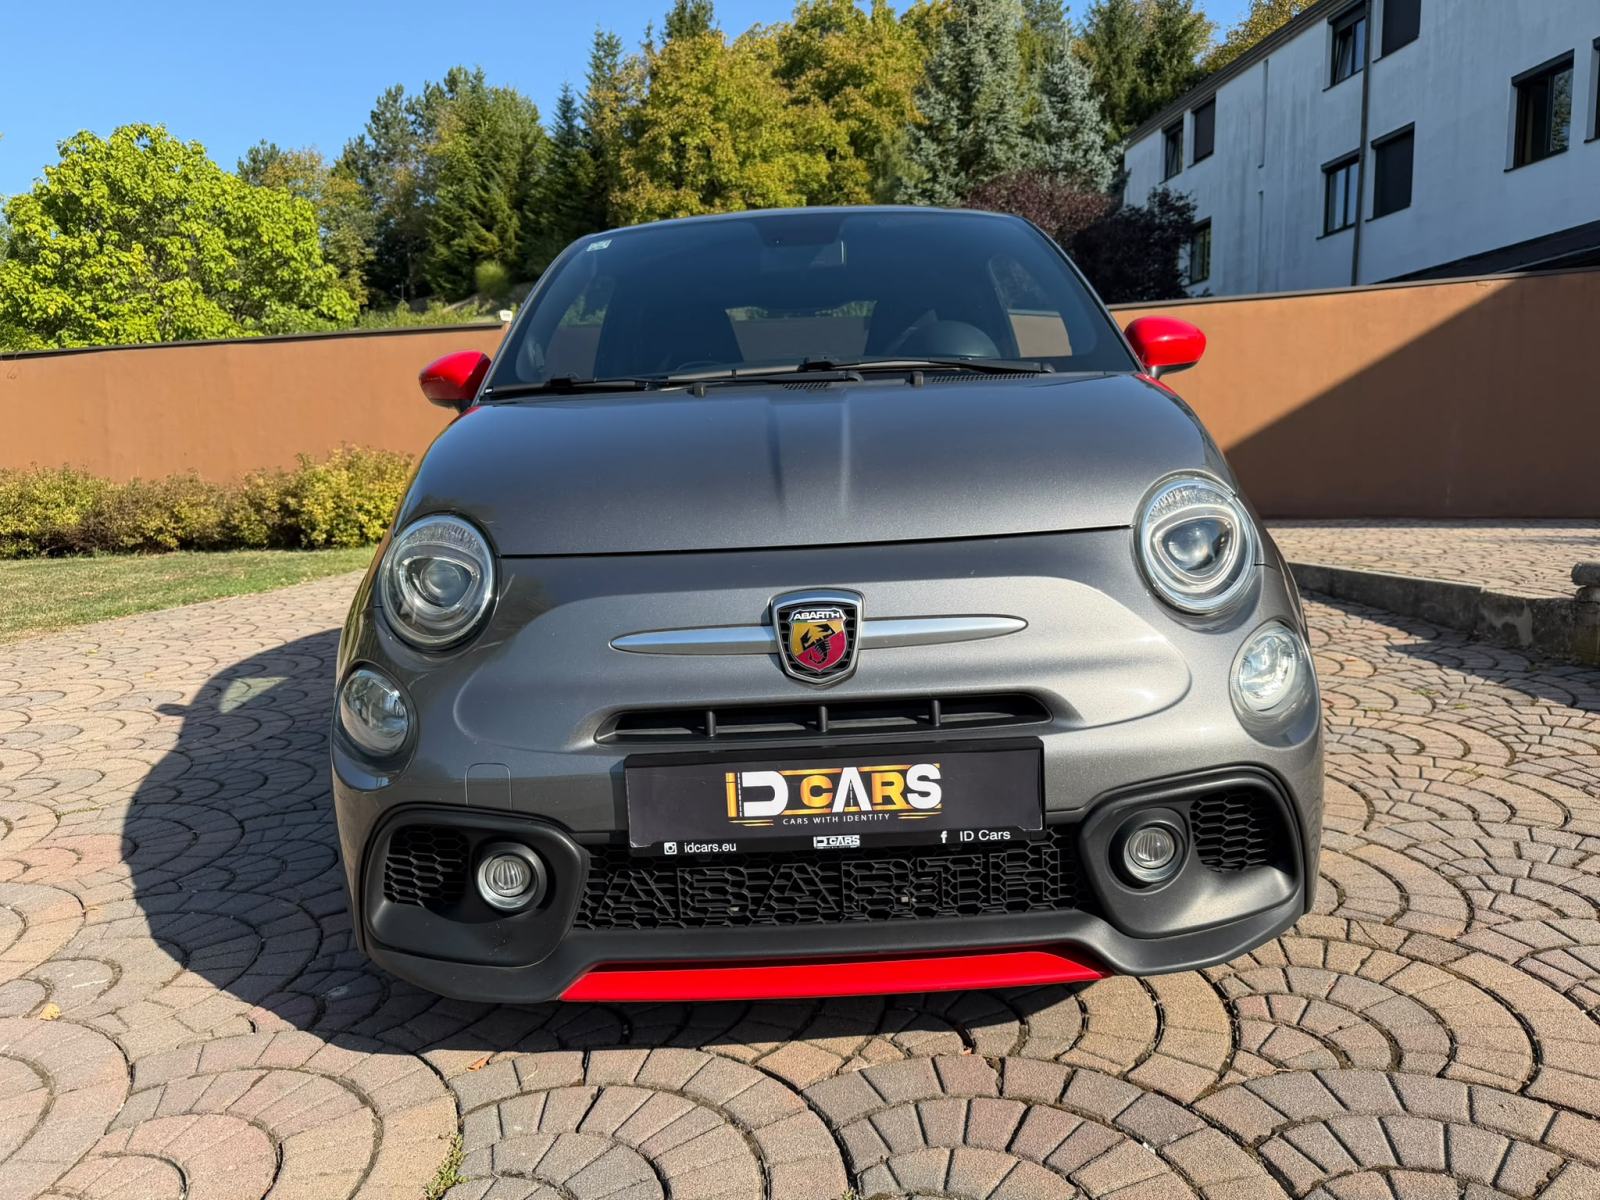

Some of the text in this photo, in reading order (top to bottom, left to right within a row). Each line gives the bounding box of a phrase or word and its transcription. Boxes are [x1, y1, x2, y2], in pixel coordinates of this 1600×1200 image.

[793, 611, 840, 620] ABARTH
[726, 763, 942, 817] ID CARS
[782, 813, 890, 826] CARS WITH IDENTITY
[829, 835, 860, 846] CARS
[959, 828, 1011, 841] ID Cars
[684, 841, 737, 854] idcars.eu
[594, 848, 1060, 920] ABARTH
